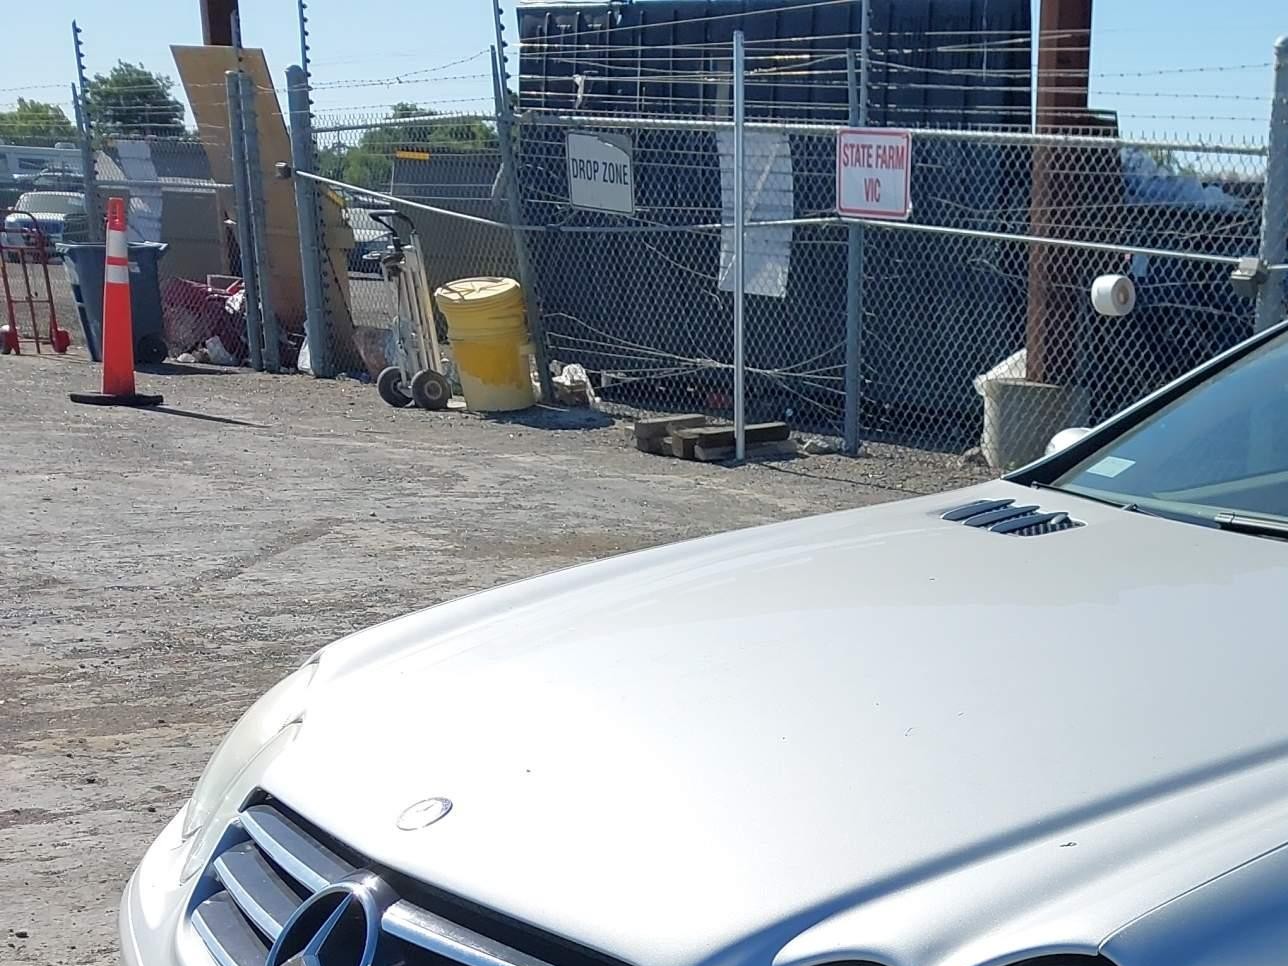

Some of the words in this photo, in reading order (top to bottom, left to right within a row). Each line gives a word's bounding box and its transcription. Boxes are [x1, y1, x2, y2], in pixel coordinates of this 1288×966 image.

[842, 143, 874, 169] STATE
[875, 144, 905, 170] FARM
[571, 158, 600, 181] DROP
[602, 161, 629, 186] ZONE
[863, 177, 881, 203] VIC
